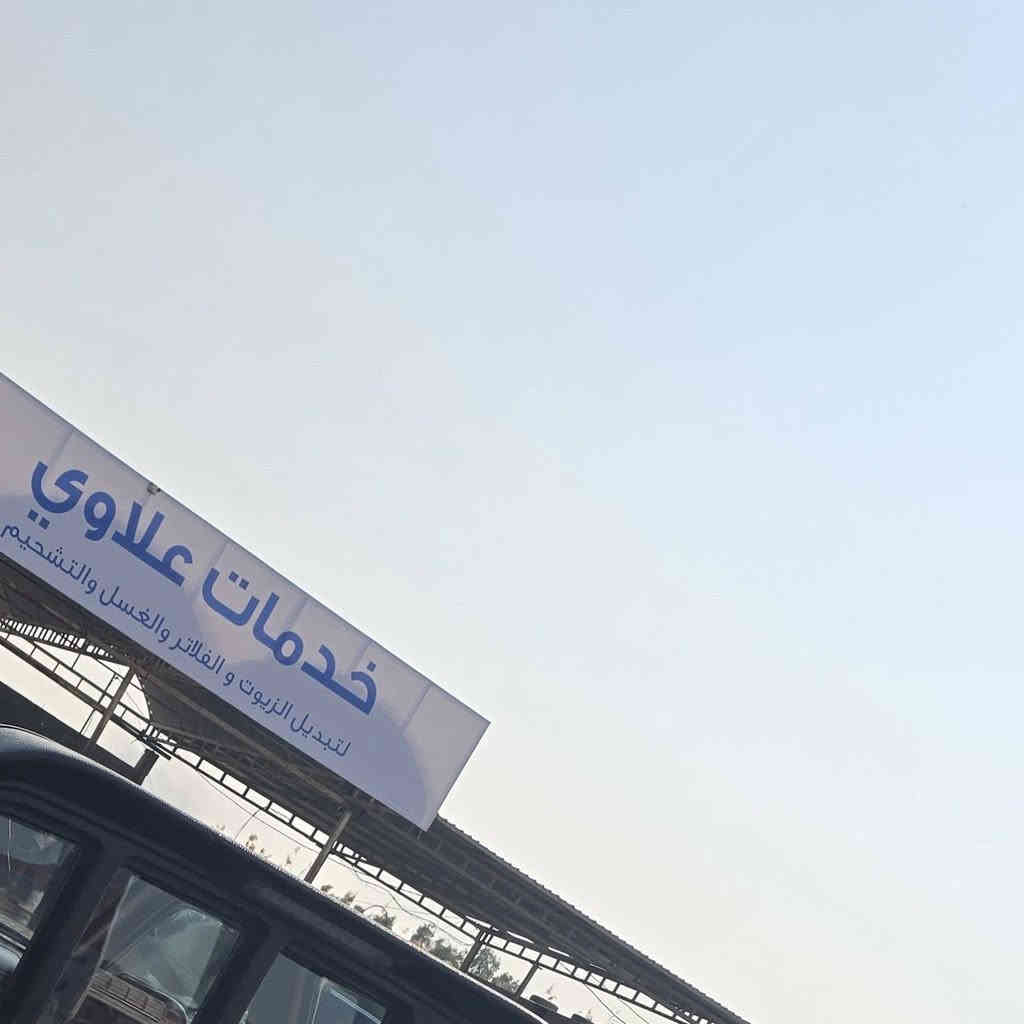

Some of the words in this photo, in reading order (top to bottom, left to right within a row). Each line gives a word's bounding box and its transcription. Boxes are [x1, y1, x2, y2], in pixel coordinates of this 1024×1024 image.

[27, 461, 193, 587] علاوي
[0, 524, 98, 594] والتشحيم
[99, 586, 171, 643] والغسل
[168, 637, 226, 675] الفلاتر
[201, 567, 377, 715] خدمات
[223, 671, 235, 687] و
[239, 678, 294, 720] الزيوت
[290, 712, 352, 757] لتبديل
